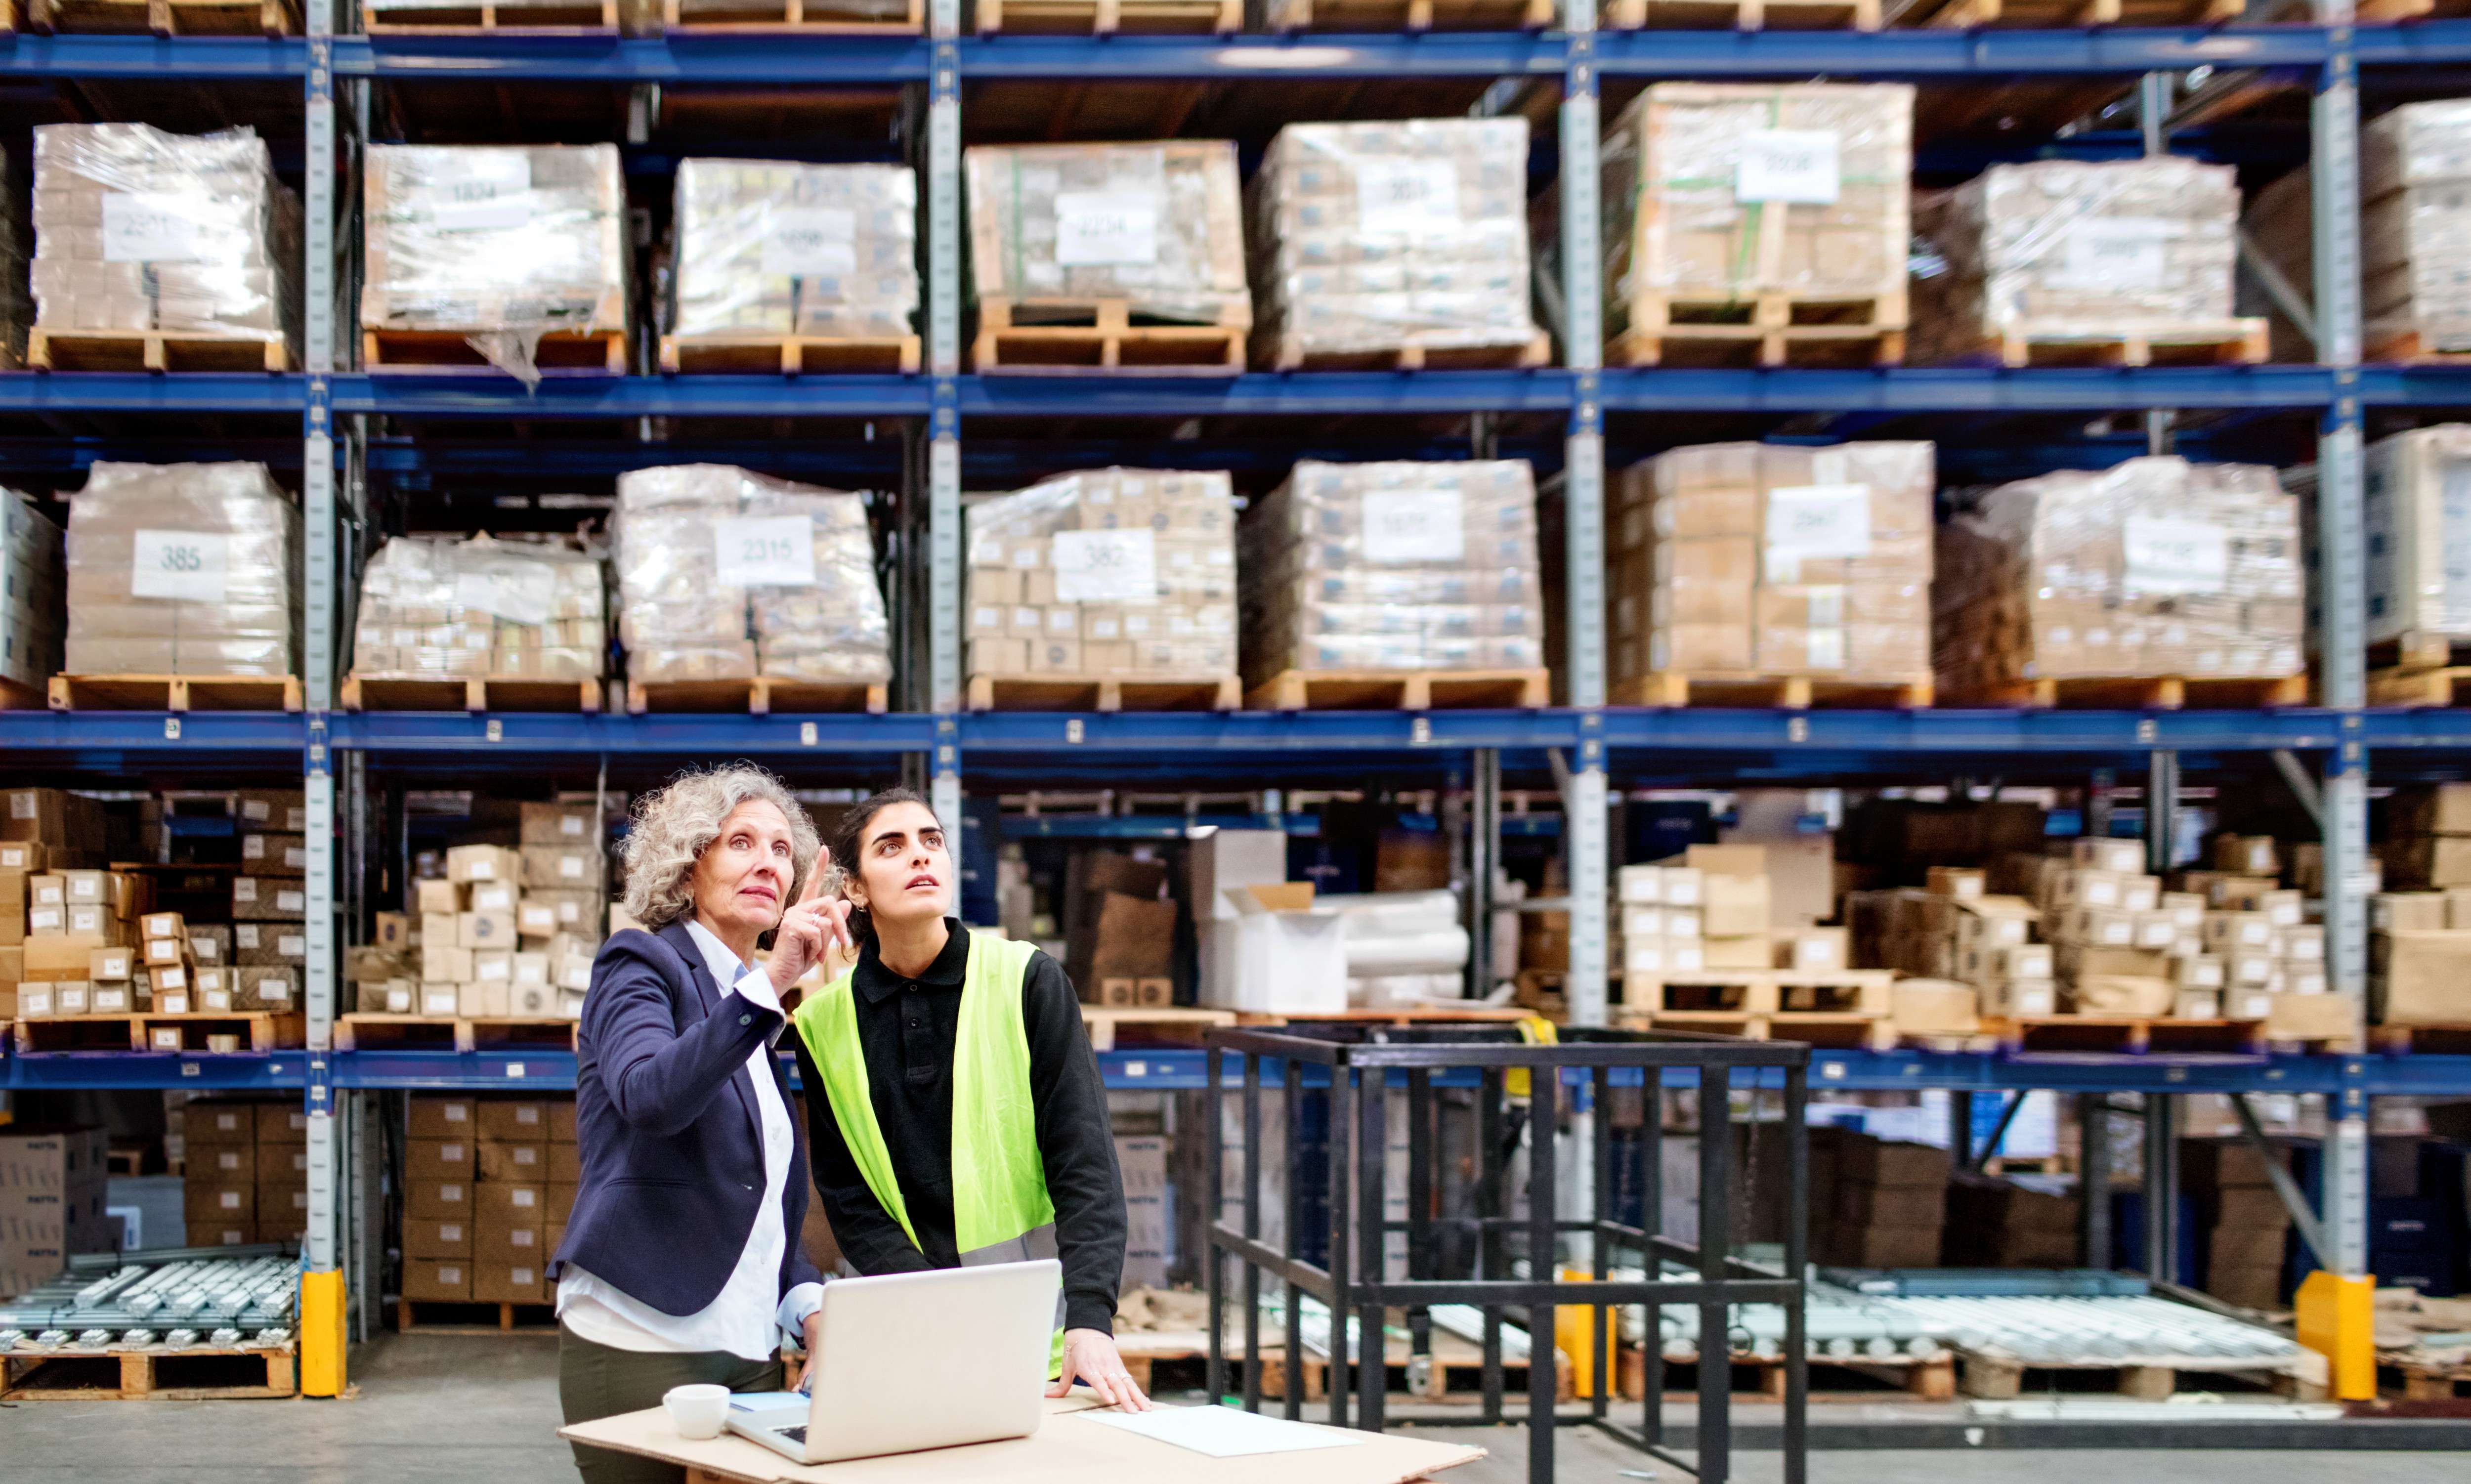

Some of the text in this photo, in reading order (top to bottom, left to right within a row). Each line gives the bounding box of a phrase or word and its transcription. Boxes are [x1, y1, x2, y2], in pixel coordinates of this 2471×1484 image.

[161, 545, 201, 571] 385
[741, 538, 793, 562] 2315
[1085, 544, 1123, 569] 382
